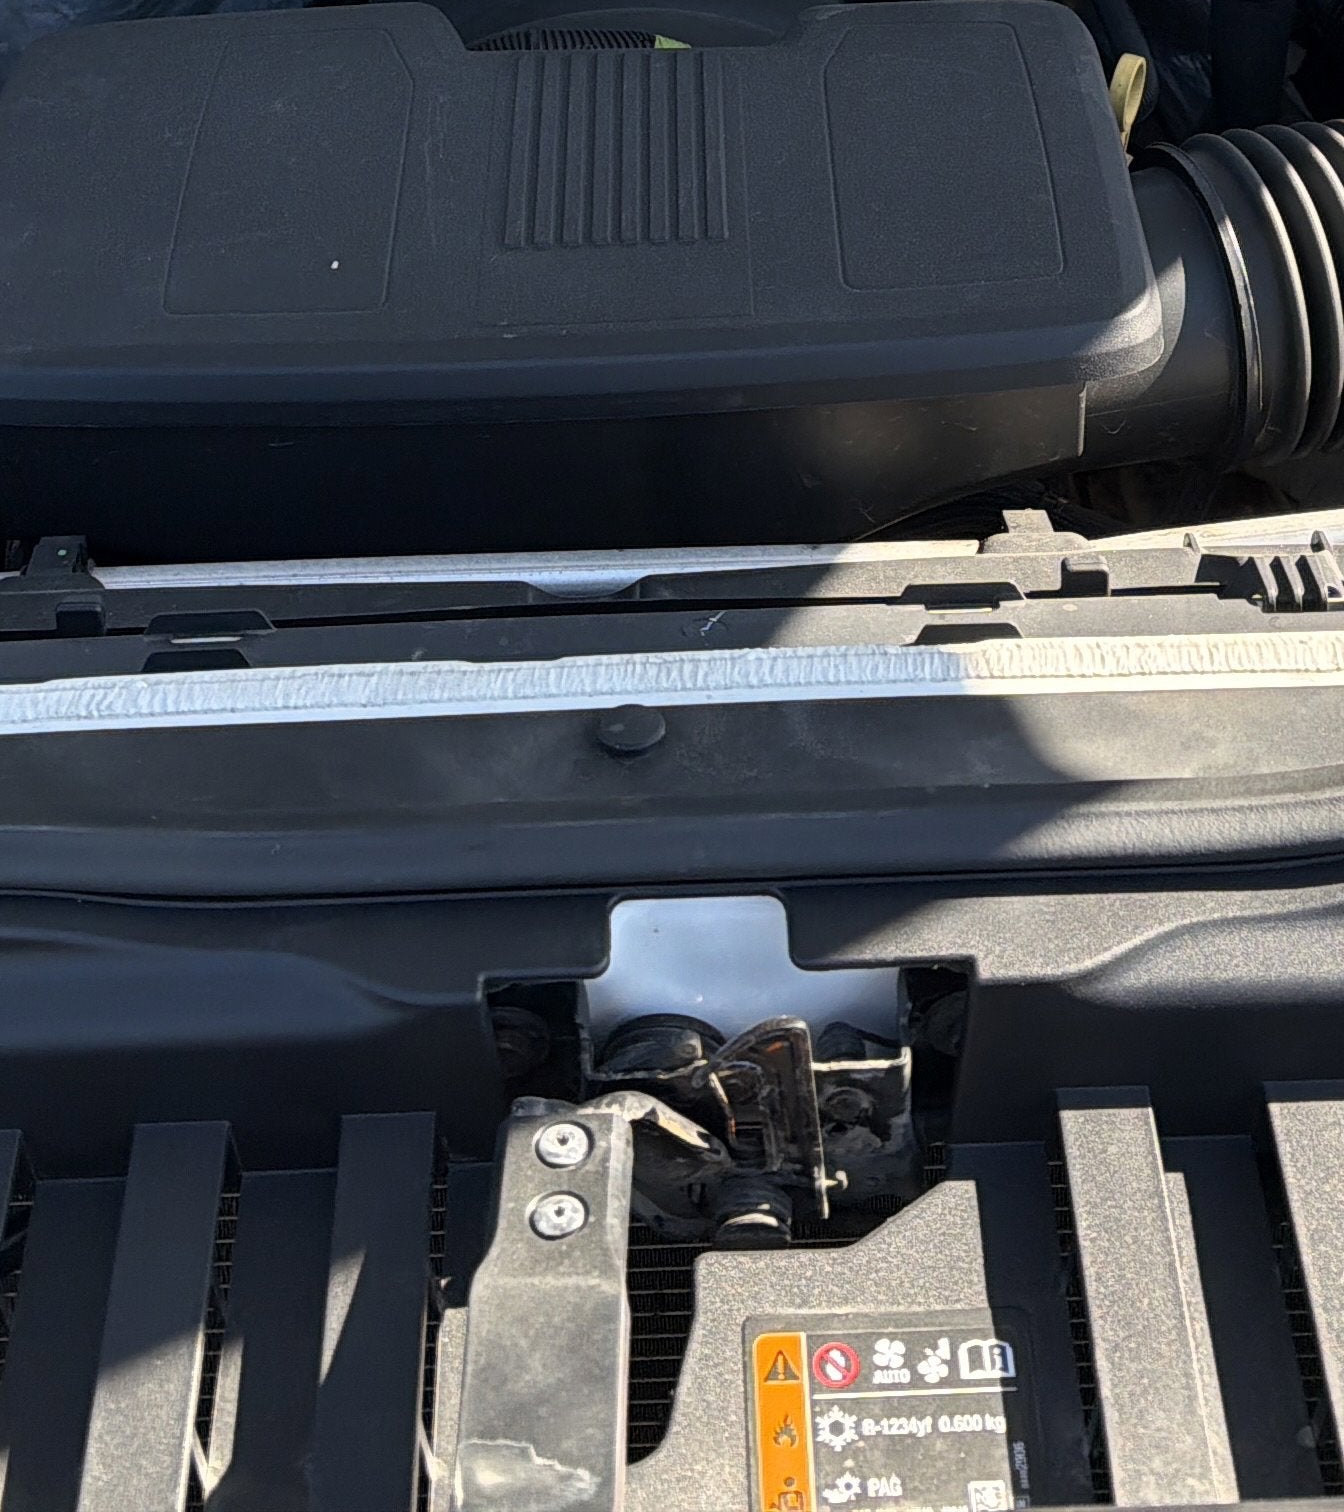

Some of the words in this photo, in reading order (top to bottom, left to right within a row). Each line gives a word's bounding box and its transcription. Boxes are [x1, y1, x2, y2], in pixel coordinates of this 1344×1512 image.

[872, 1368, 911, 1384] AUTO
[861, 1416, 933, 1437] R-1234yf
[938, 1414, 983, 1433] 0.600
[985, 1413, 1006, 1434] kg
[867, 1474, 903, 1498] PAG
